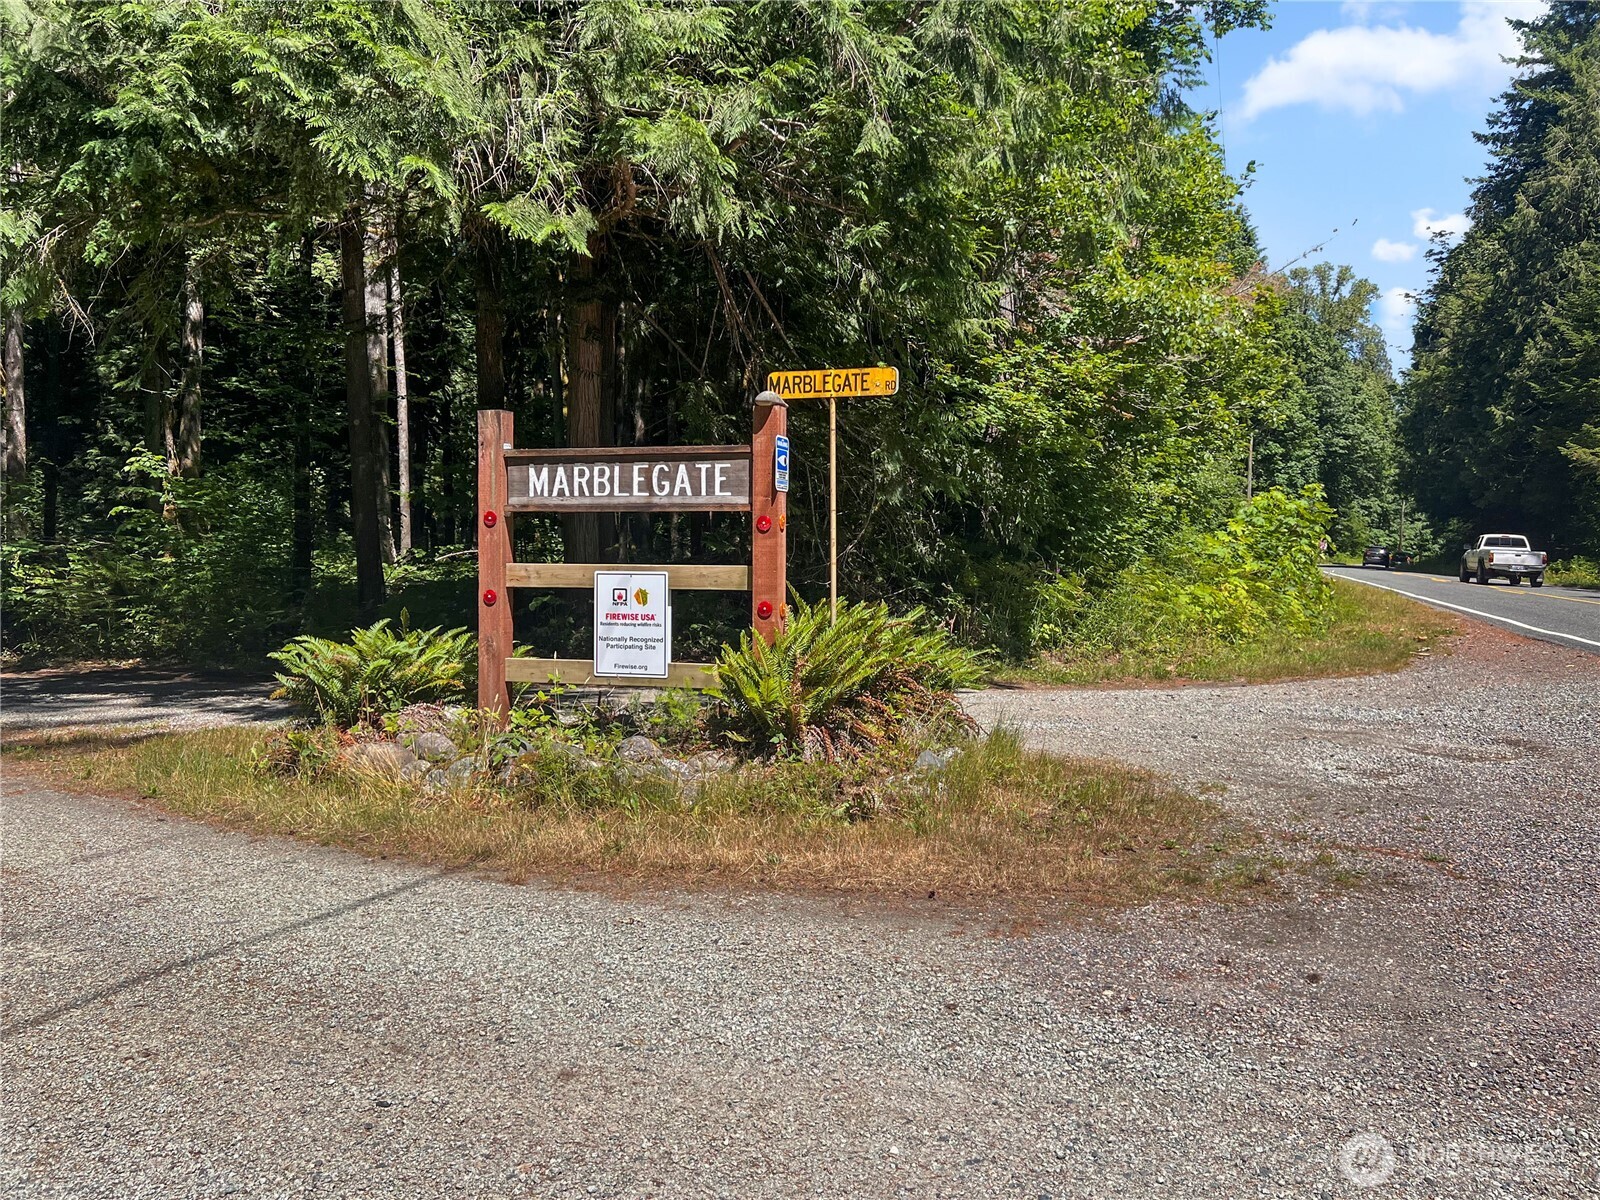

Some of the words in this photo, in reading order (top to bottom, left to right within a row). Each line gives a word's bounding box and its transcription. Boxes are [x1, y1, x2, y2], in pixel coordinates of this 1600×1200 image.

[769, 373, 870, 395] MARBLEGATE
[885, 381, 896, 391] RD
[528, 463, 732, 497] MARBLEGATE
[605, 613, 639, 621] FIREWISE
[606, 643, 643, 651] Participating
